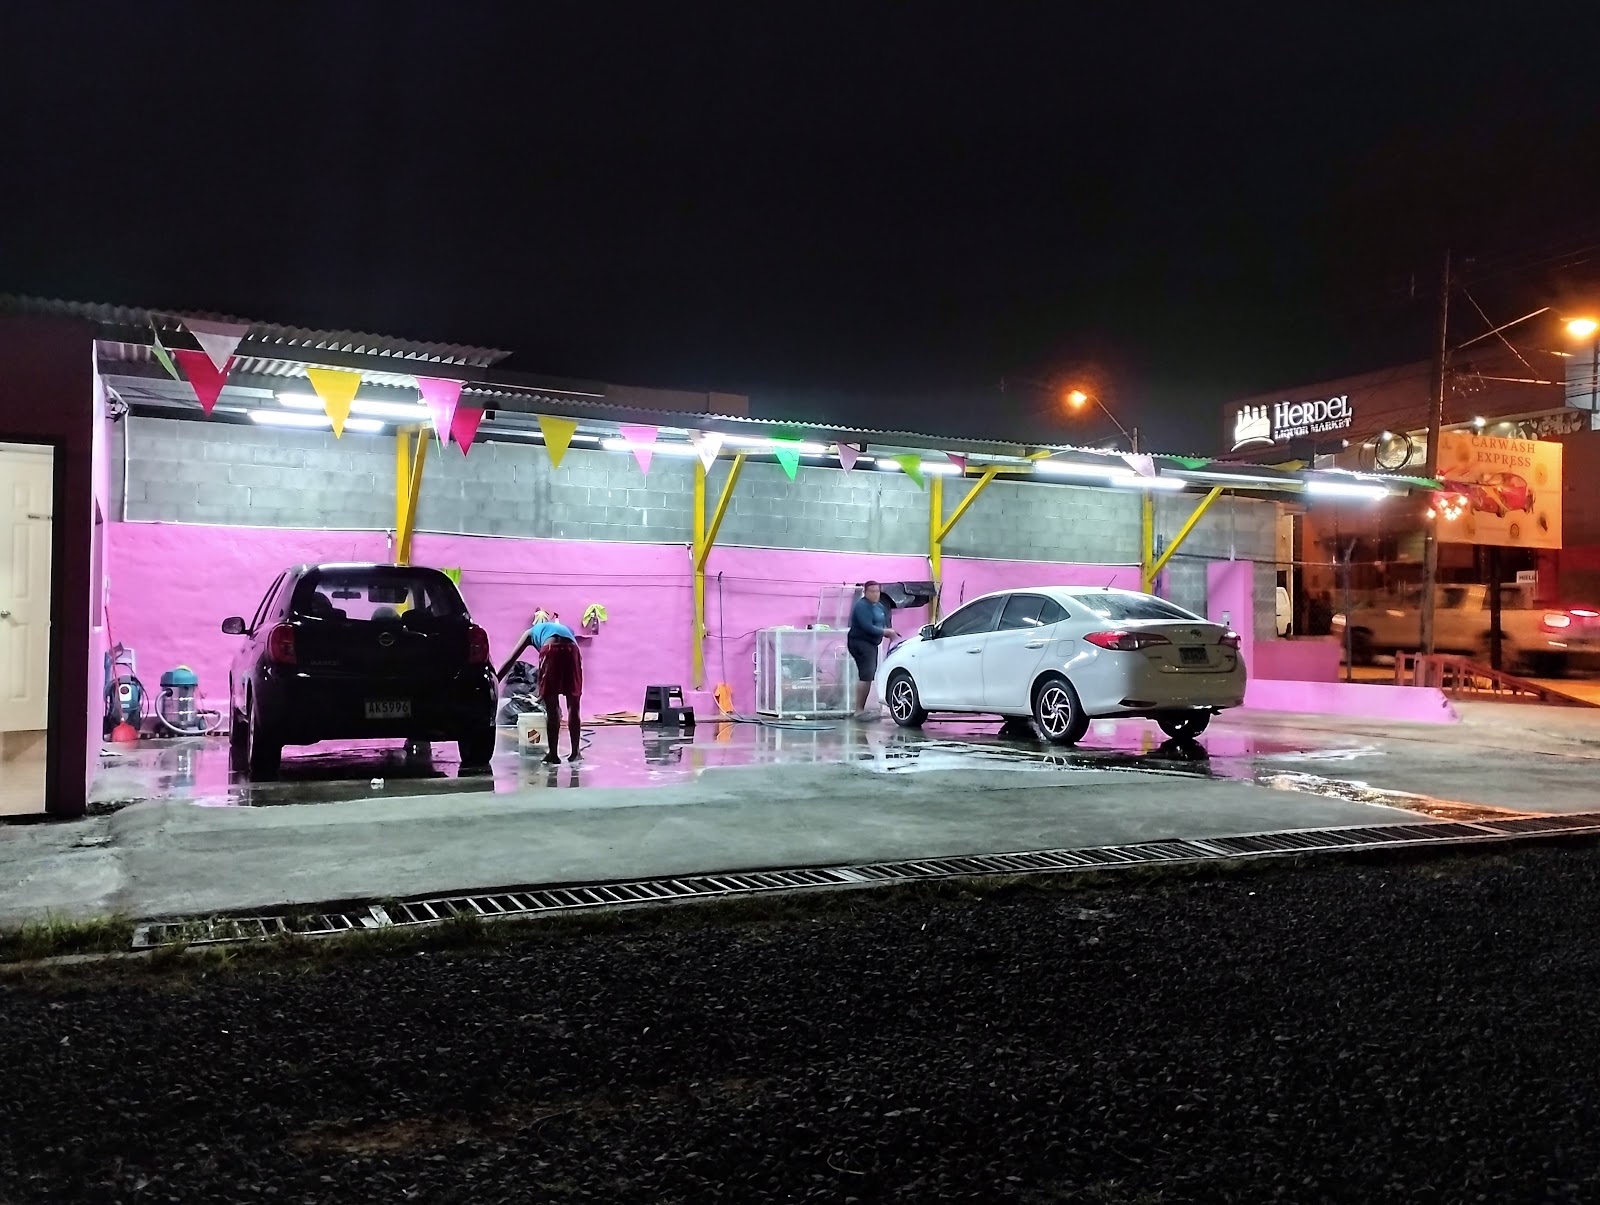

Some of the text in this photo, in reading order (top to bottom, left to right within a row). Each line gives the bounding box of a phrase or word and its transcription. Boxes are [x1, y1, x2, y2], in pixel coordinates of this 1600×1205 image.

[1274, 417, 1353, 443] LIQUOR MARKET
[1471, 436, 1536, 454] CARWASH
[1476, 451, 1532, 468] EXPRESS
[368, 702, 409, 713] AK5996
